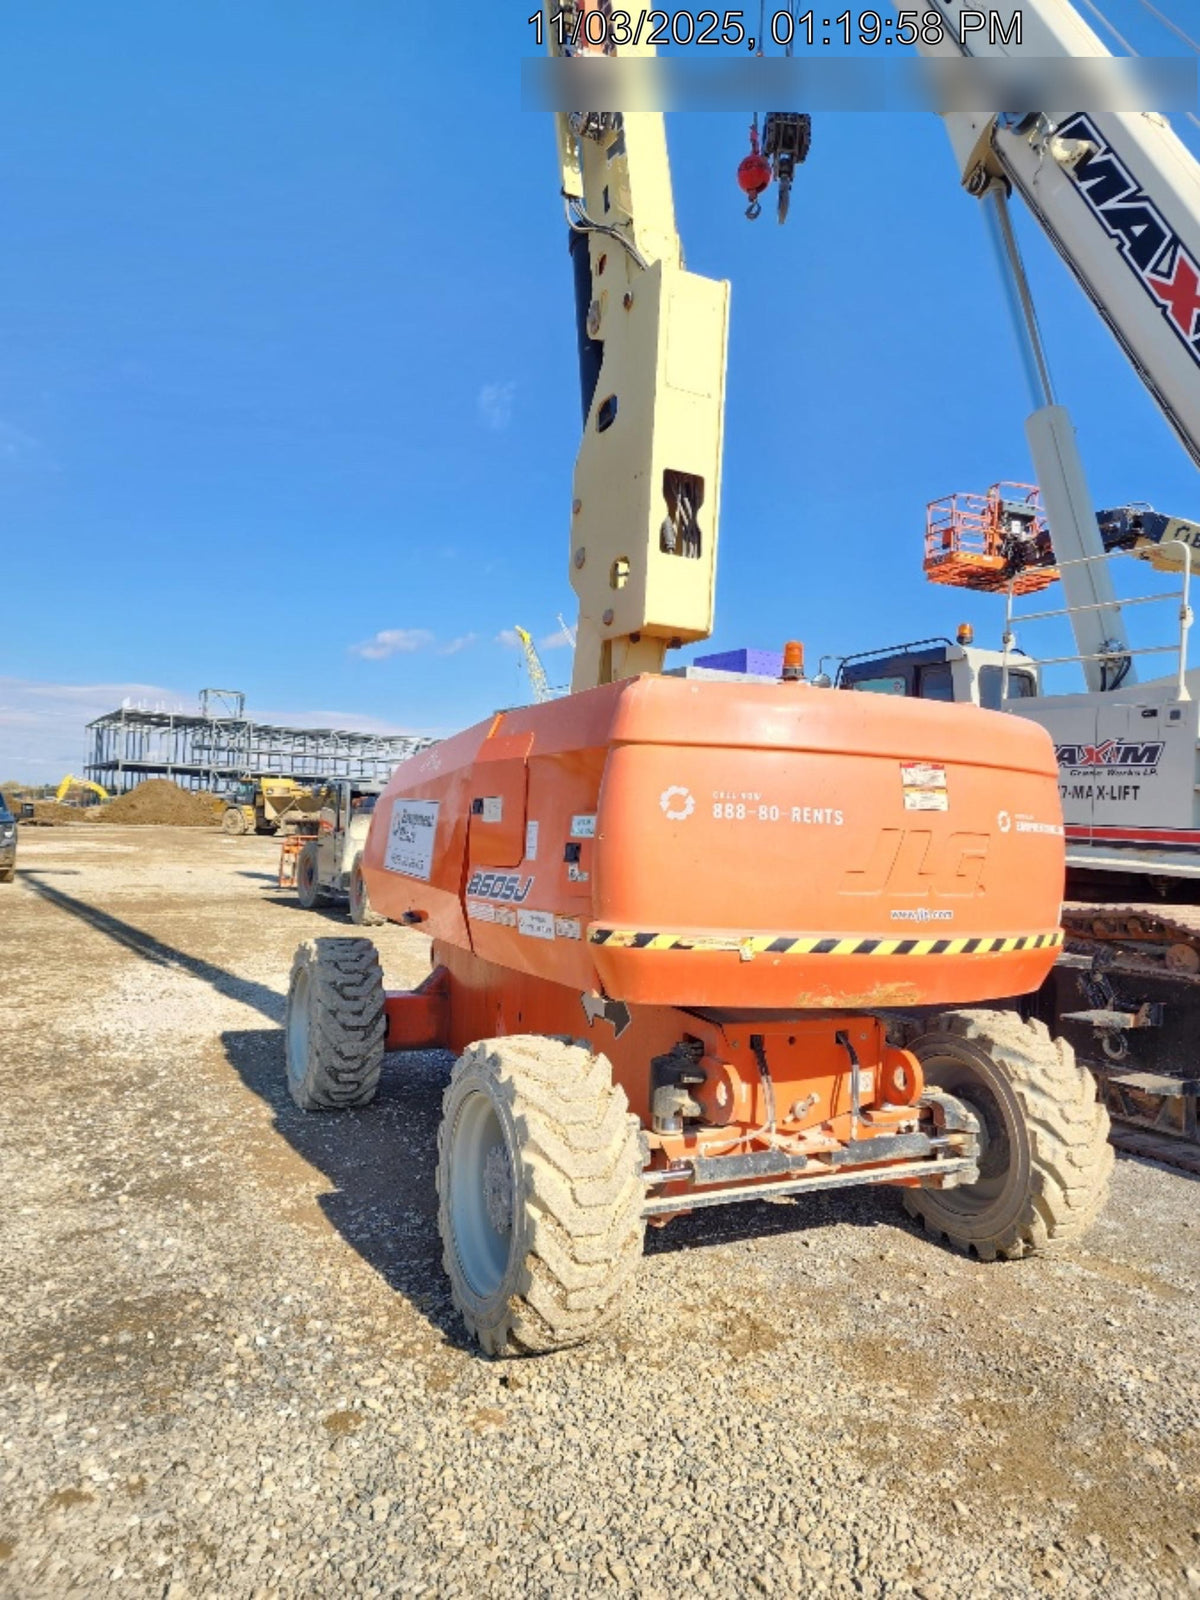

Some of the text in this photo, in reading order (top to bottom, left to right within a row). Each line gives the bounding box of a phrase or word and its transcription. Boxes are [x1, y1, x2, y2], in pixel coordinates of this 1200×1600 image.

[1053, 738, 1166, 768] AXIM
[1058, 785, 1140, 801] 7-MAX-LIFT
[712, 802, 845, 826] 888-80-RENTS
[838, 828, 991, 896] JLG
